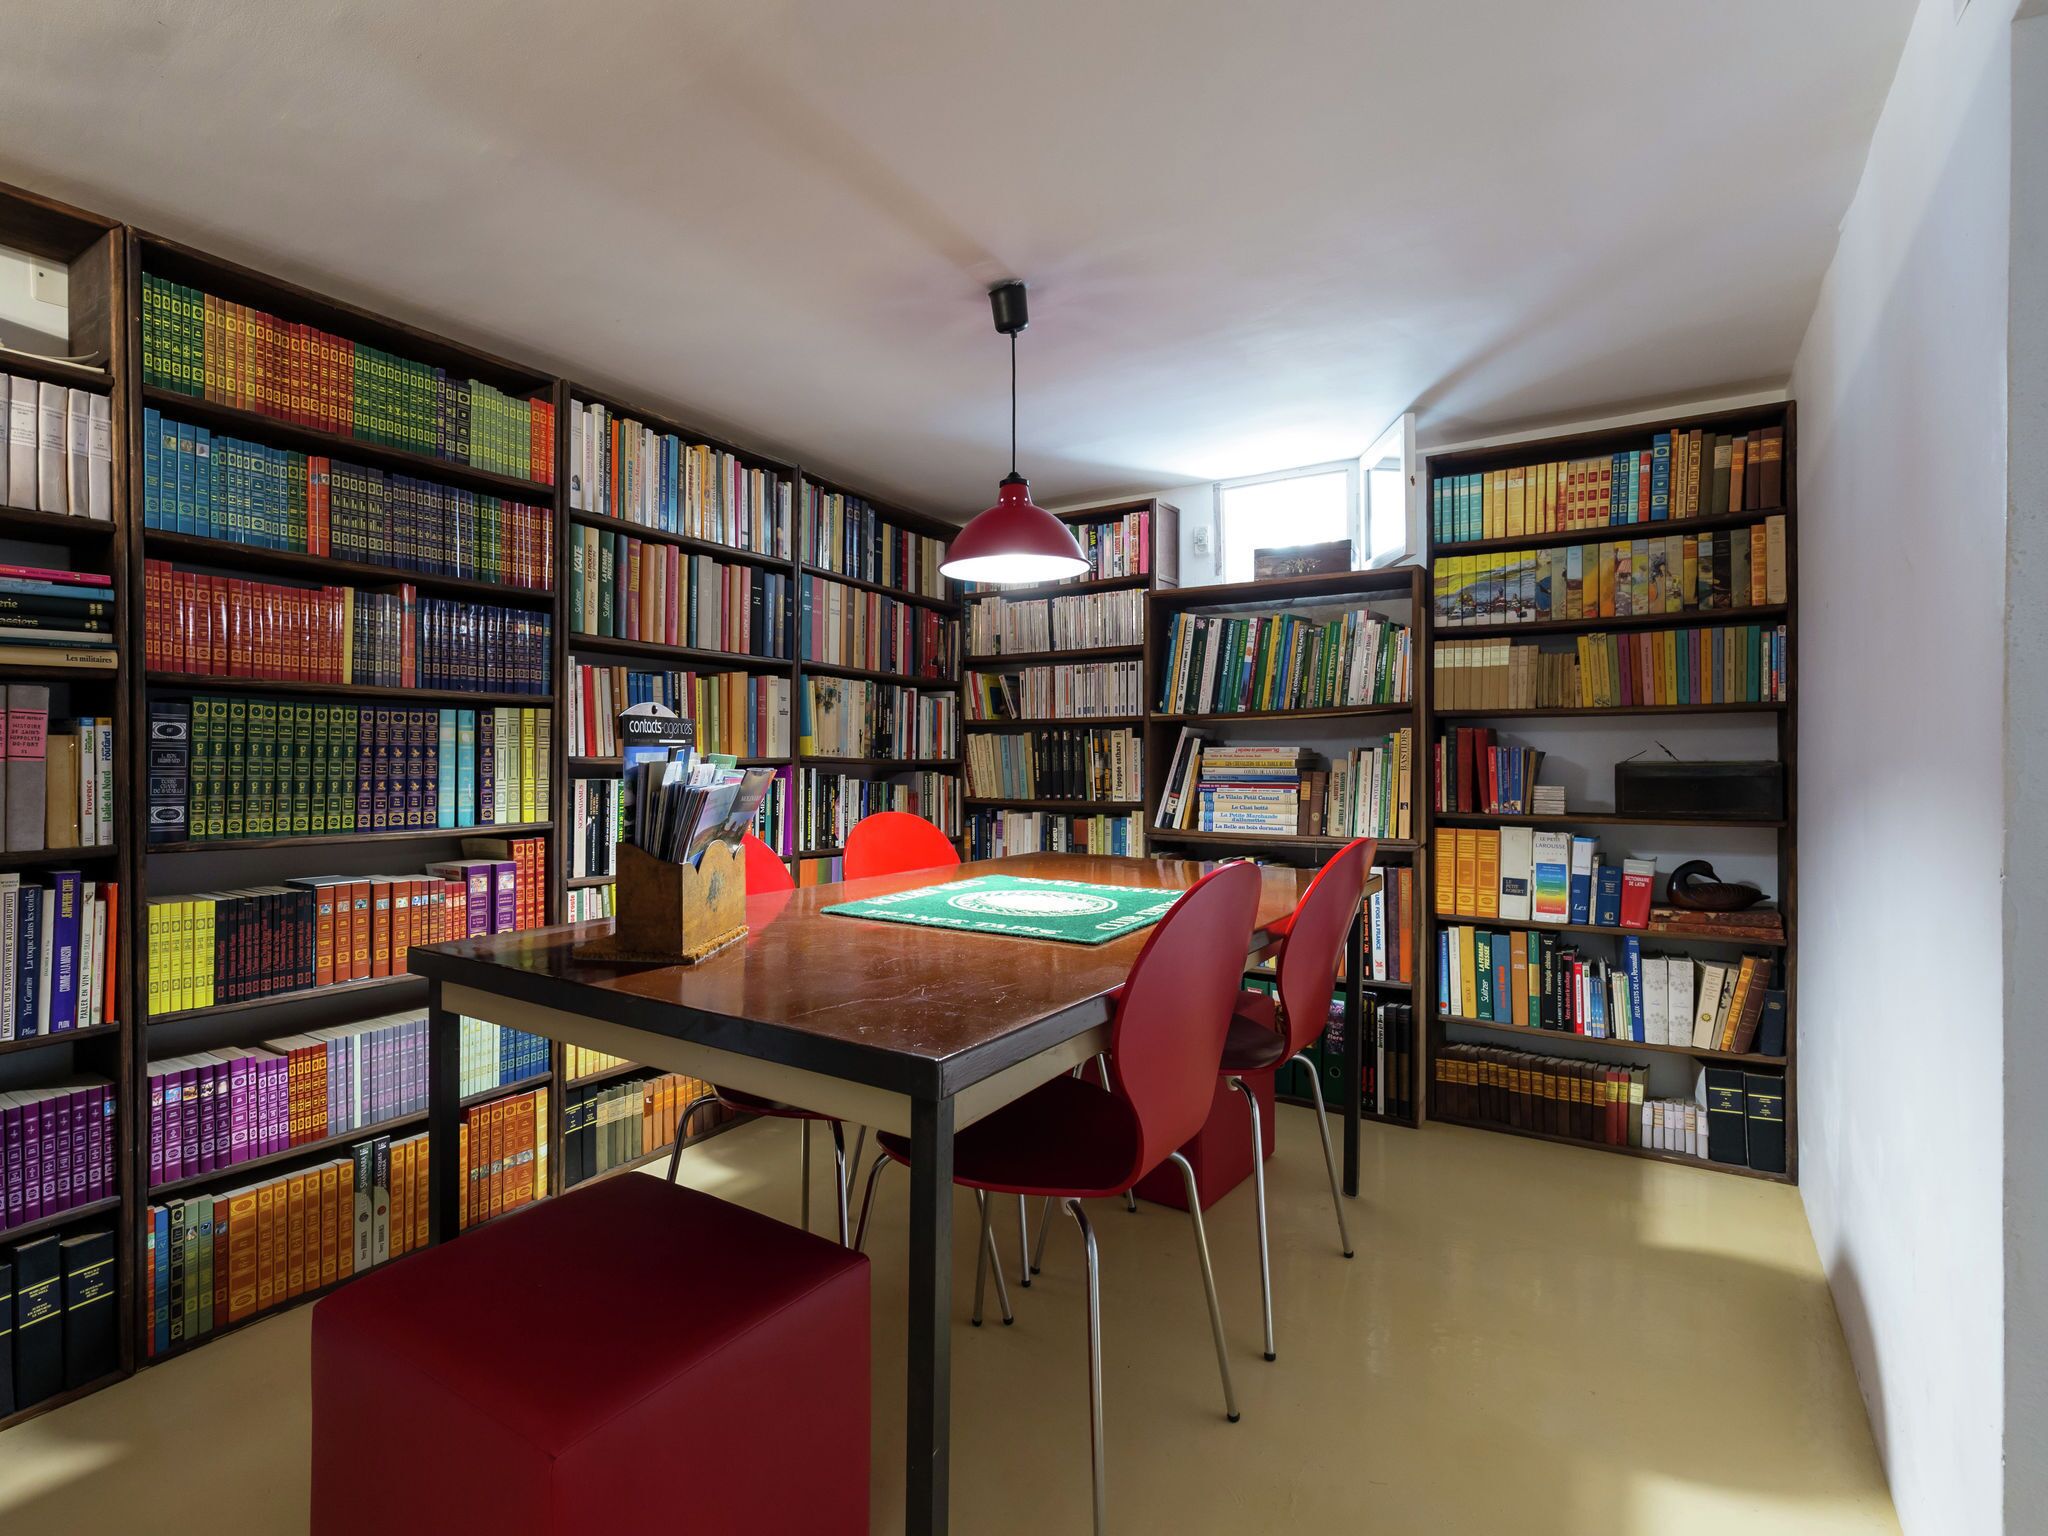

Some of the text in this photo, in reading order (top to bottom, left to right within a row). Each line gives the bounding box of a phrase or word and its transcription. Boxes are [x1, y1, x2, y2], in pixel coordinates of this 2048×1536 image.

[574, 545, 583, 573] KATE
[66, 654, 78, 662] Les
[1400, 729, 1408, 771] BASTIDES
[85, 780, 93, 816] Provence
[102, 771, 112, 822] Italie du Nord
[1573, 903, 1587, 911] Les
[25, 913, 34, 921] les
[25, 922, 34, 939] dans
[26, 940, 35, 959] toque
[24, 960, 34, 970] La
[81, 974, 89, 986] VIN
[4, 992, 12, 1002] DU
[1481, 980, 1489, 1003] Sulitzer
[80, 999, 88, 1019] PARLER
[1632, 990, 1640, 1018] JEUX-TESTS
[3, 1004, 12, 1034] MANUEL
